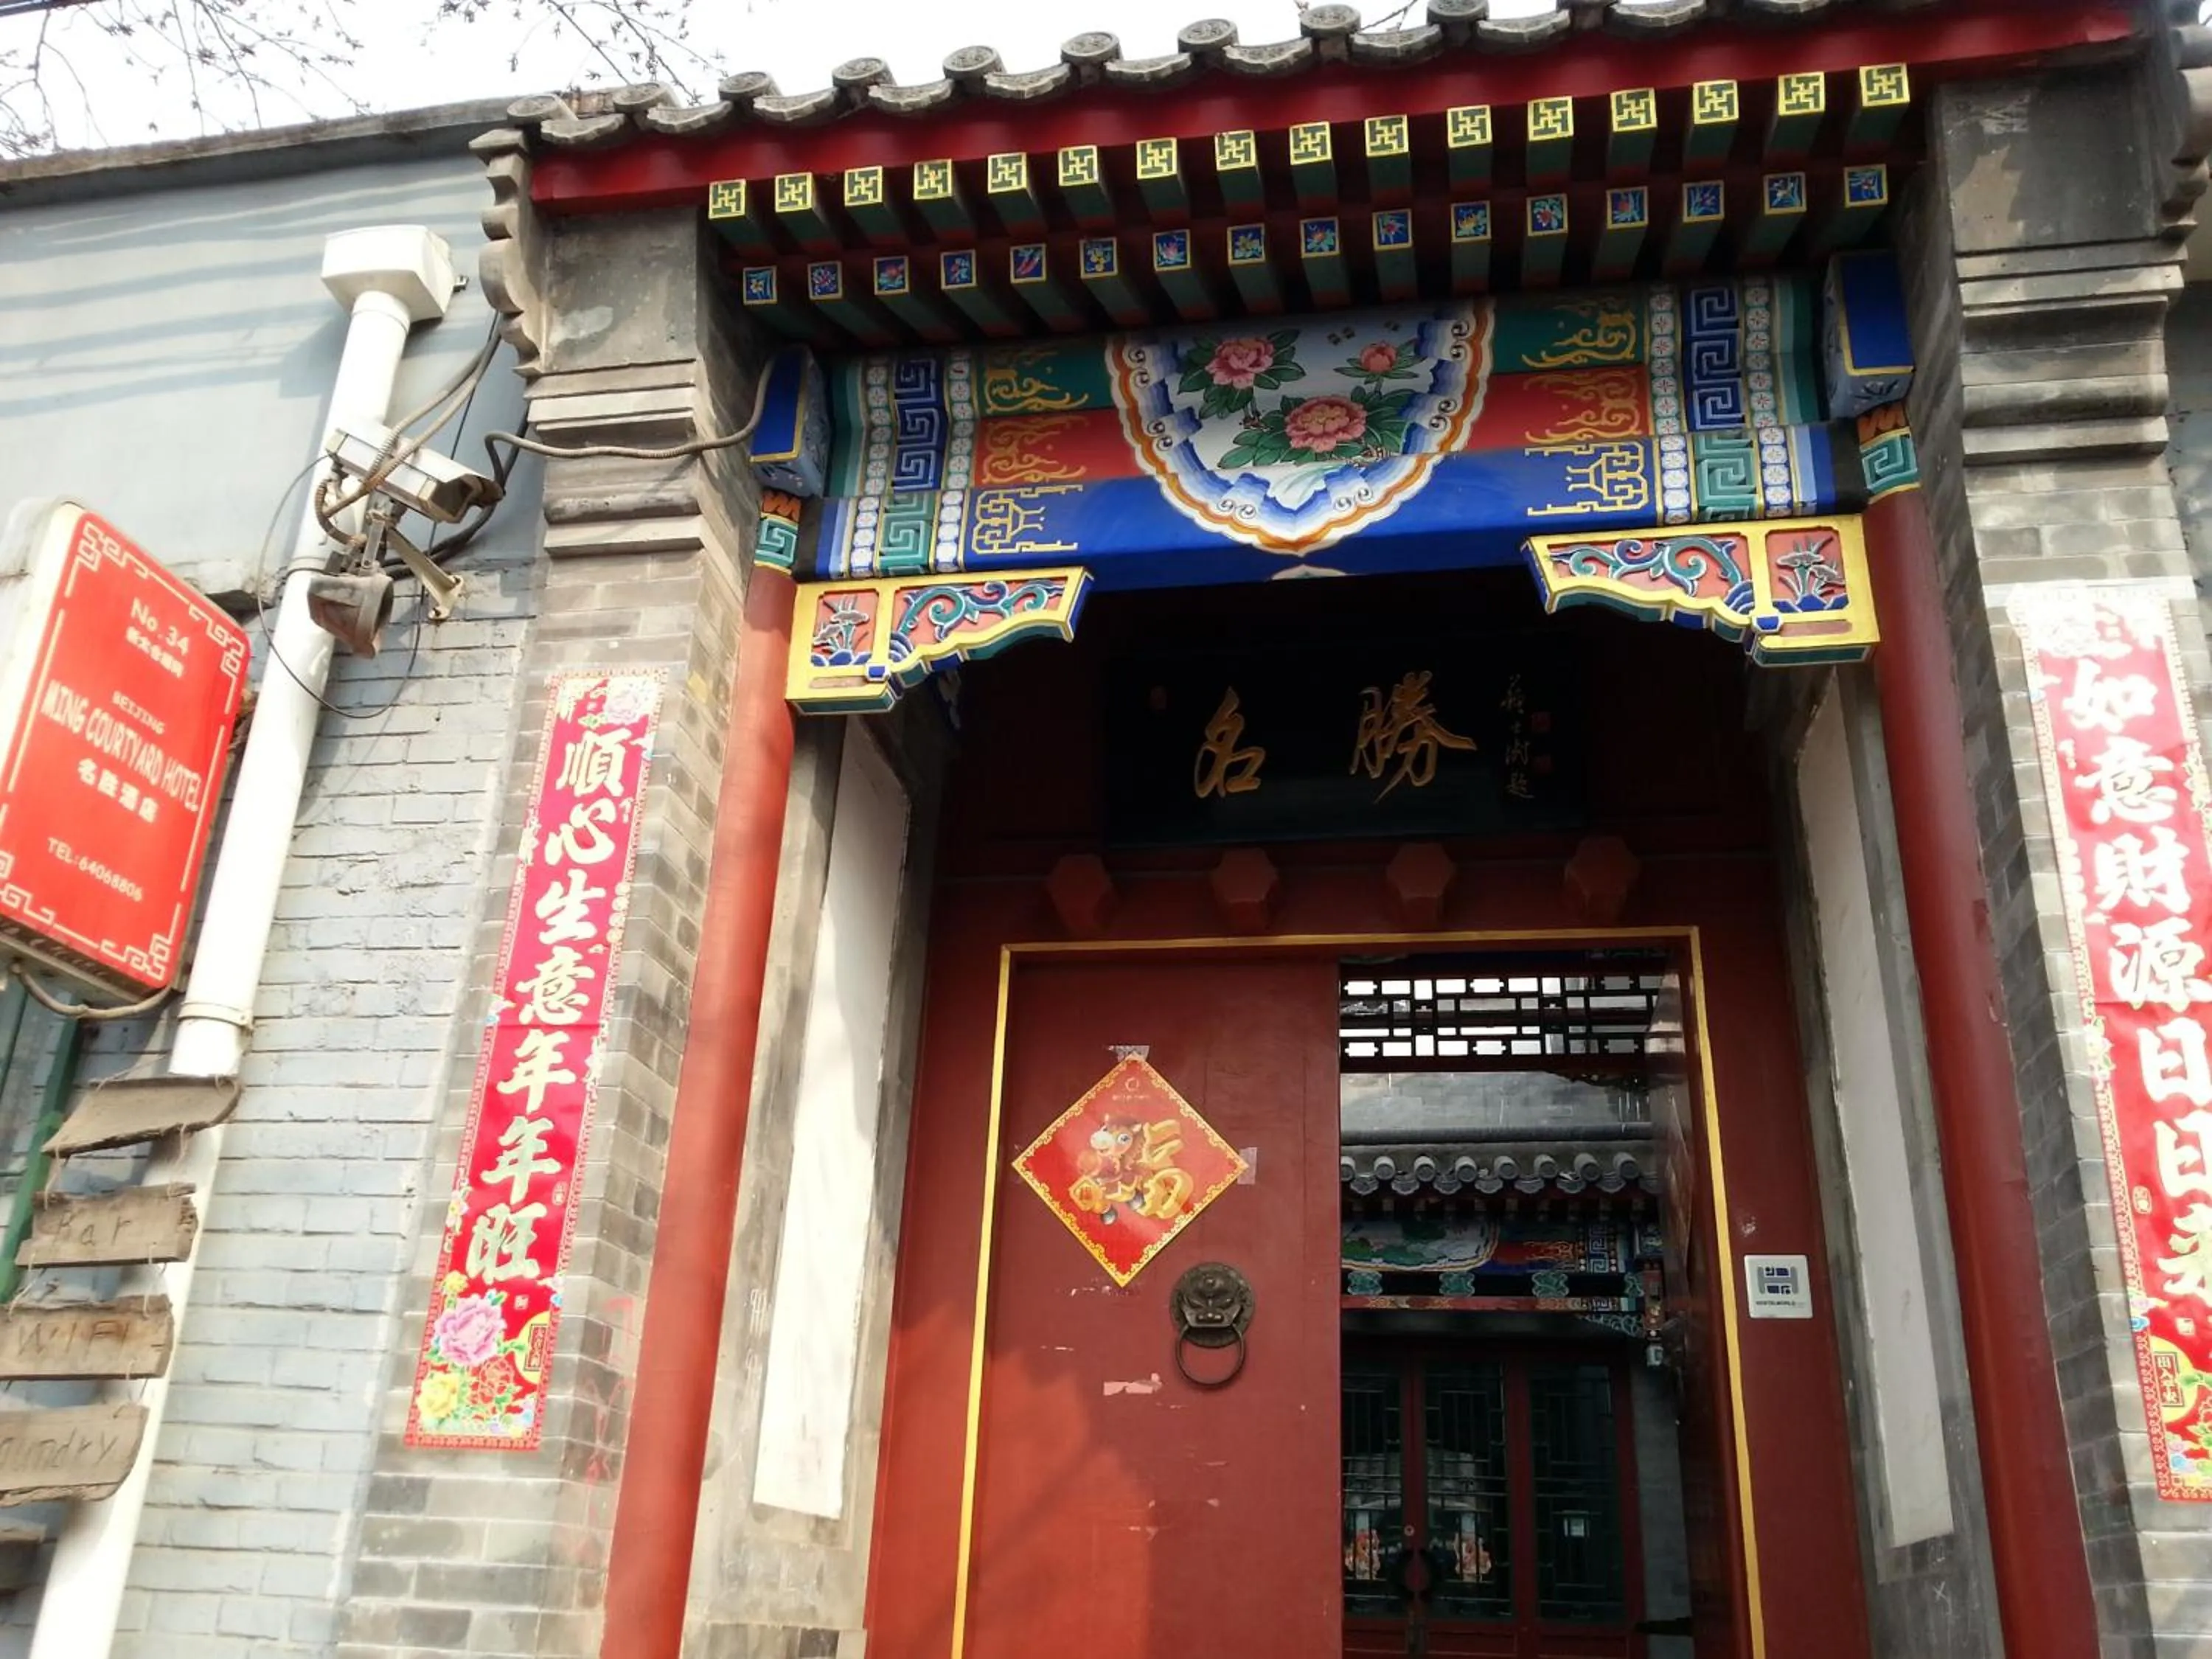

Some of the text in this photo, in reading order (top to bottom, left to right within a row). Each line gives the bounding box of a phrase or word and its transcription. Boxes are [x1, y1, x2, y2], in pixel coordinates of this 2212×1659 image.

[41, 680, 201, 813] MING COURTYARD HOTEL
[111, 689, 166, 736] BEIJING
[466, 728, 632, 1284] 順心生意年年旺
